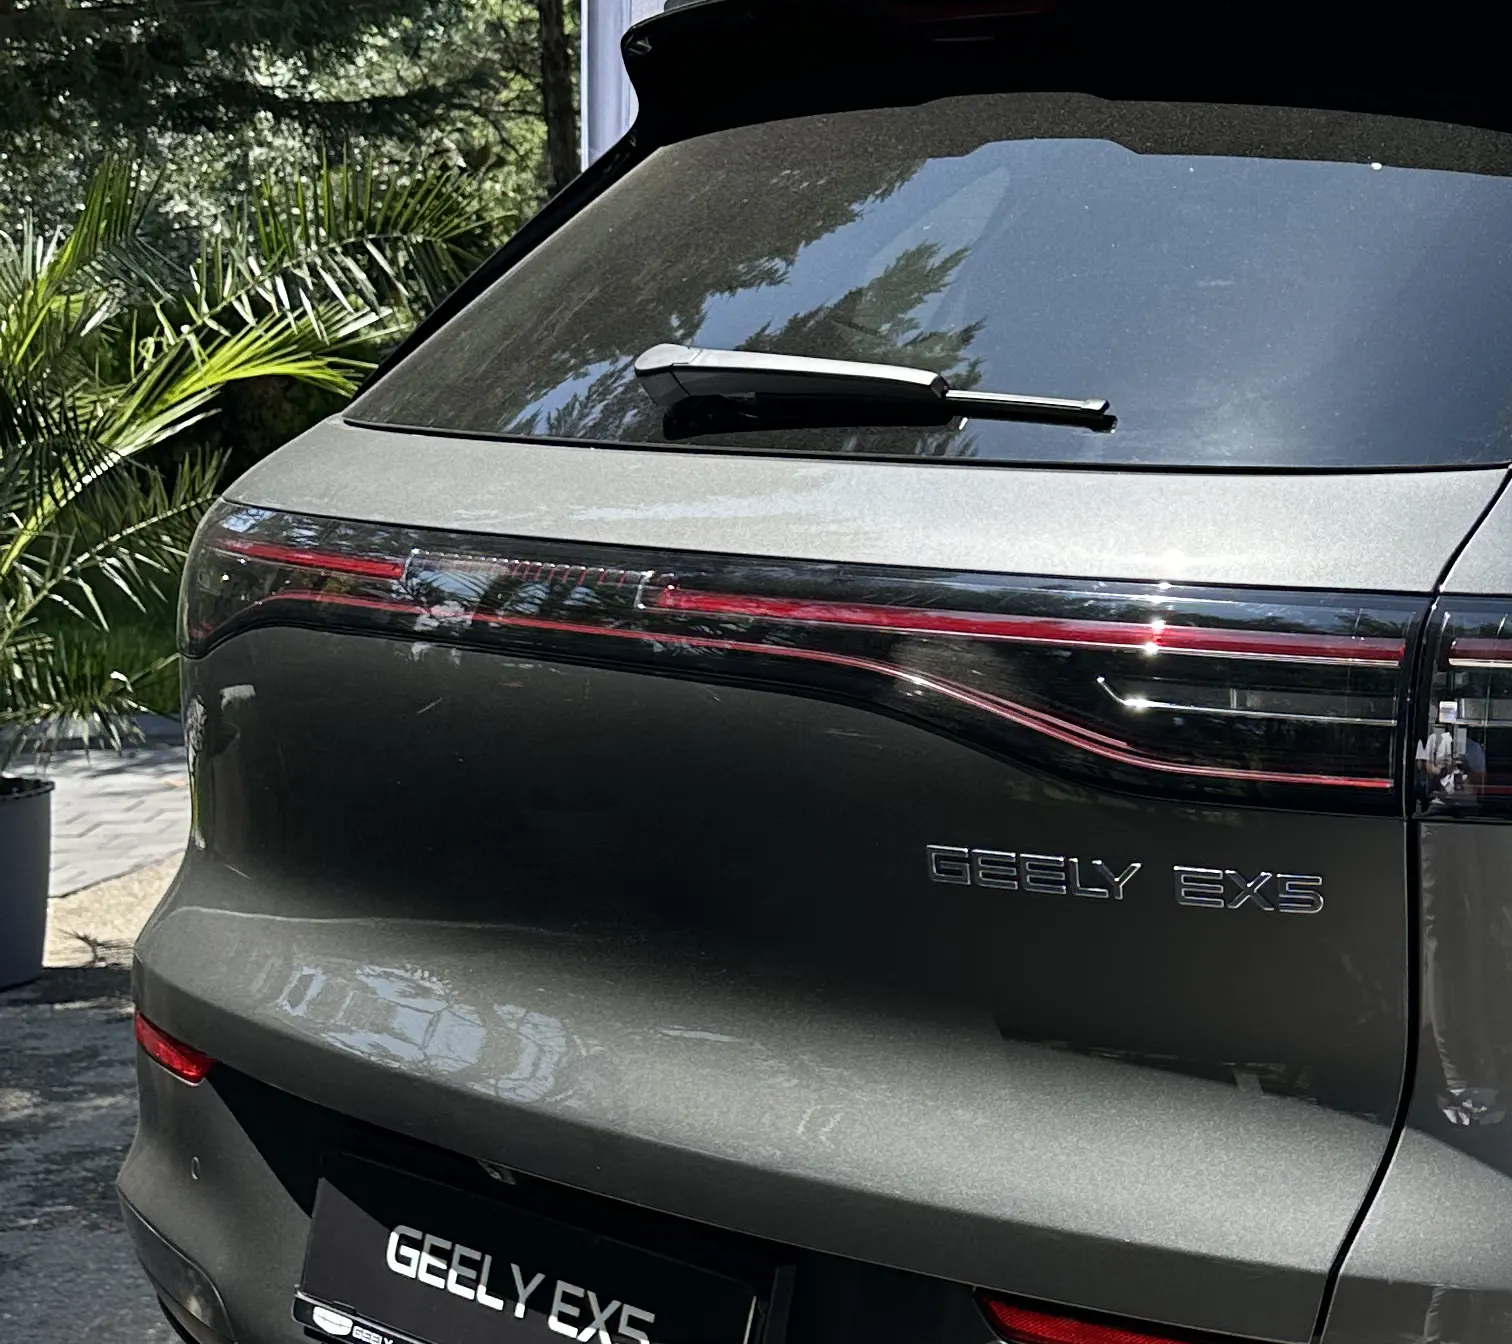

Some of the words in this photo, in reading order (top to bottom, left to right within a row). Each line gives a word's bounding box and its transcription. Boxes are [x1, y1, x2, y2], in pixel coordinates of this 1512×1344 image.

[926, 843, 1142, 900] GEELY
[1173, 864, 1325, 915] EX5
[385, 1224, 546, 1319] GEELY
